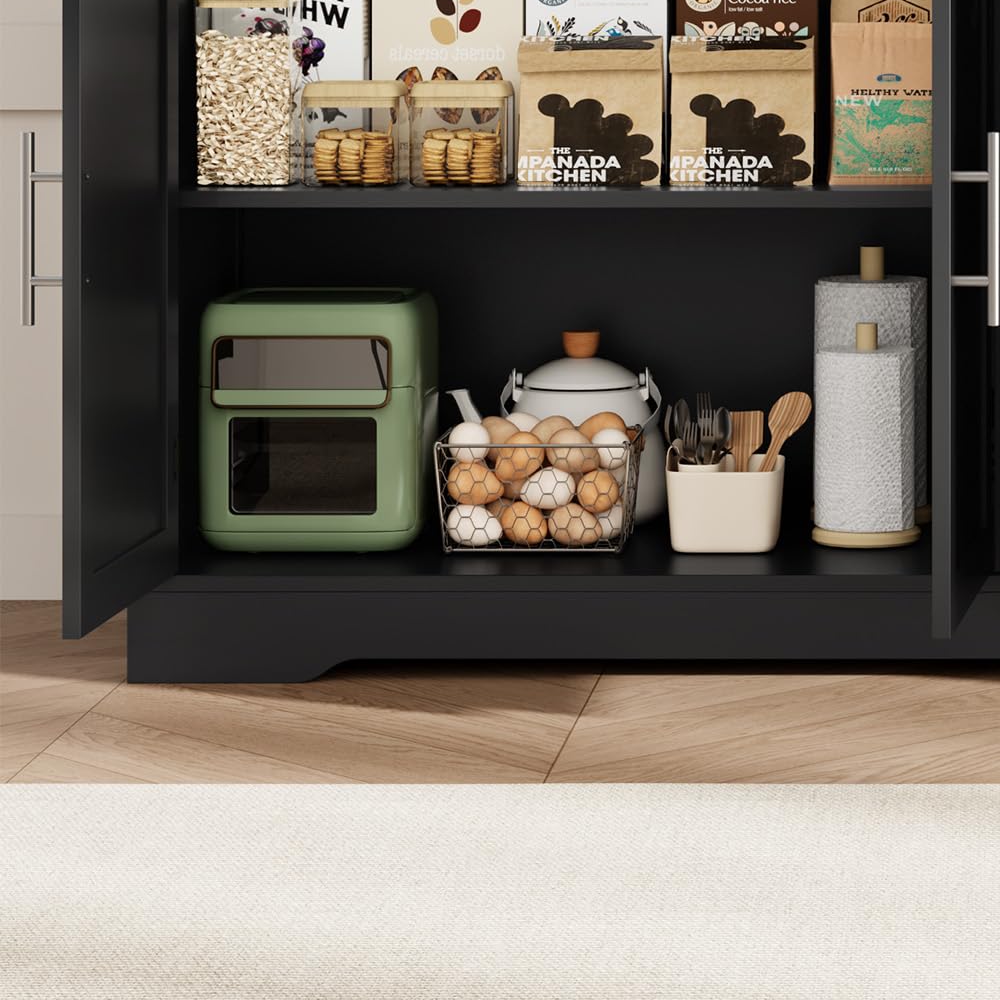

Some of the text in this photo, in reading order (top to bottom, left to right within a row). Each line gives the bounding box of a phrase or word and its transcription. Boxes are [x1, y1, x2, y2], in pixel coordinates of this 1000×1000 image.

[835, 96, 883, 107] NEW
[517, 169, 607, 183] KITCHEN
[670, 169, 759, 183] KITCHEN
